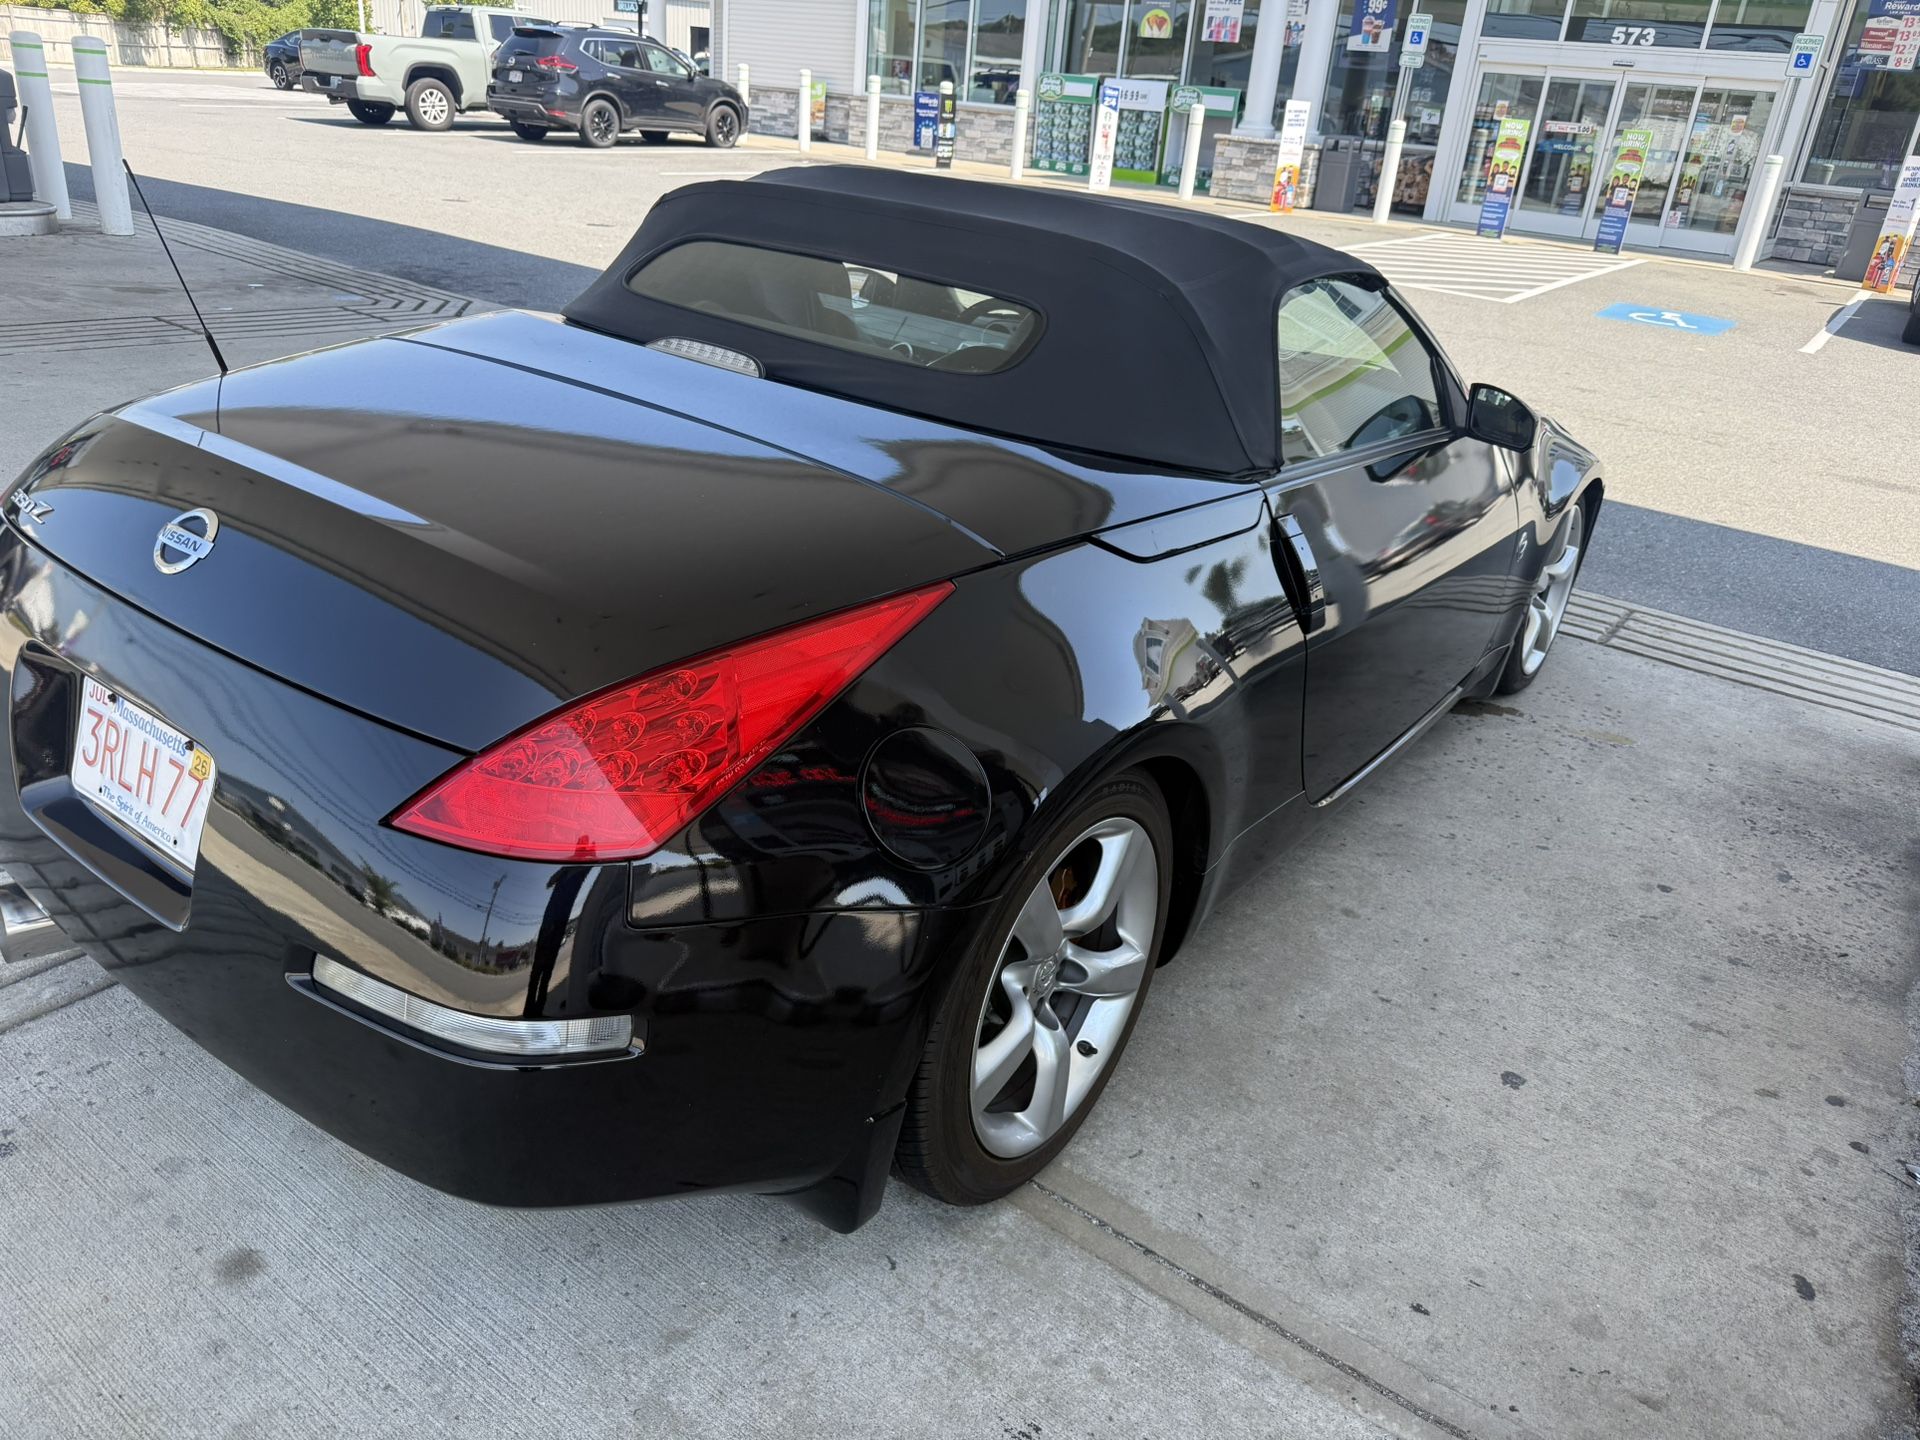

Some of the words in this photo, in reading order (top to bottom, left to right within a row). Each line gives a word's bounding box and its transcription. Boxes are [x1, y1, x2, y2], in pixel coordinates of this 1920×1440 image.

[1610, 26, 1656, 46] 573
[1627, 133, 1645, 141] NOW
[161, 526, 202, 552] NISSAN
[89, 683, 109, 706] JUL
[114, 696, 187, 757] Massachusetts
[102, 785, 115, 803] The
[117, 796, 134, 816] Spirit
[135, 809, 142, 824] of
[142, 814, 171, 843] America
